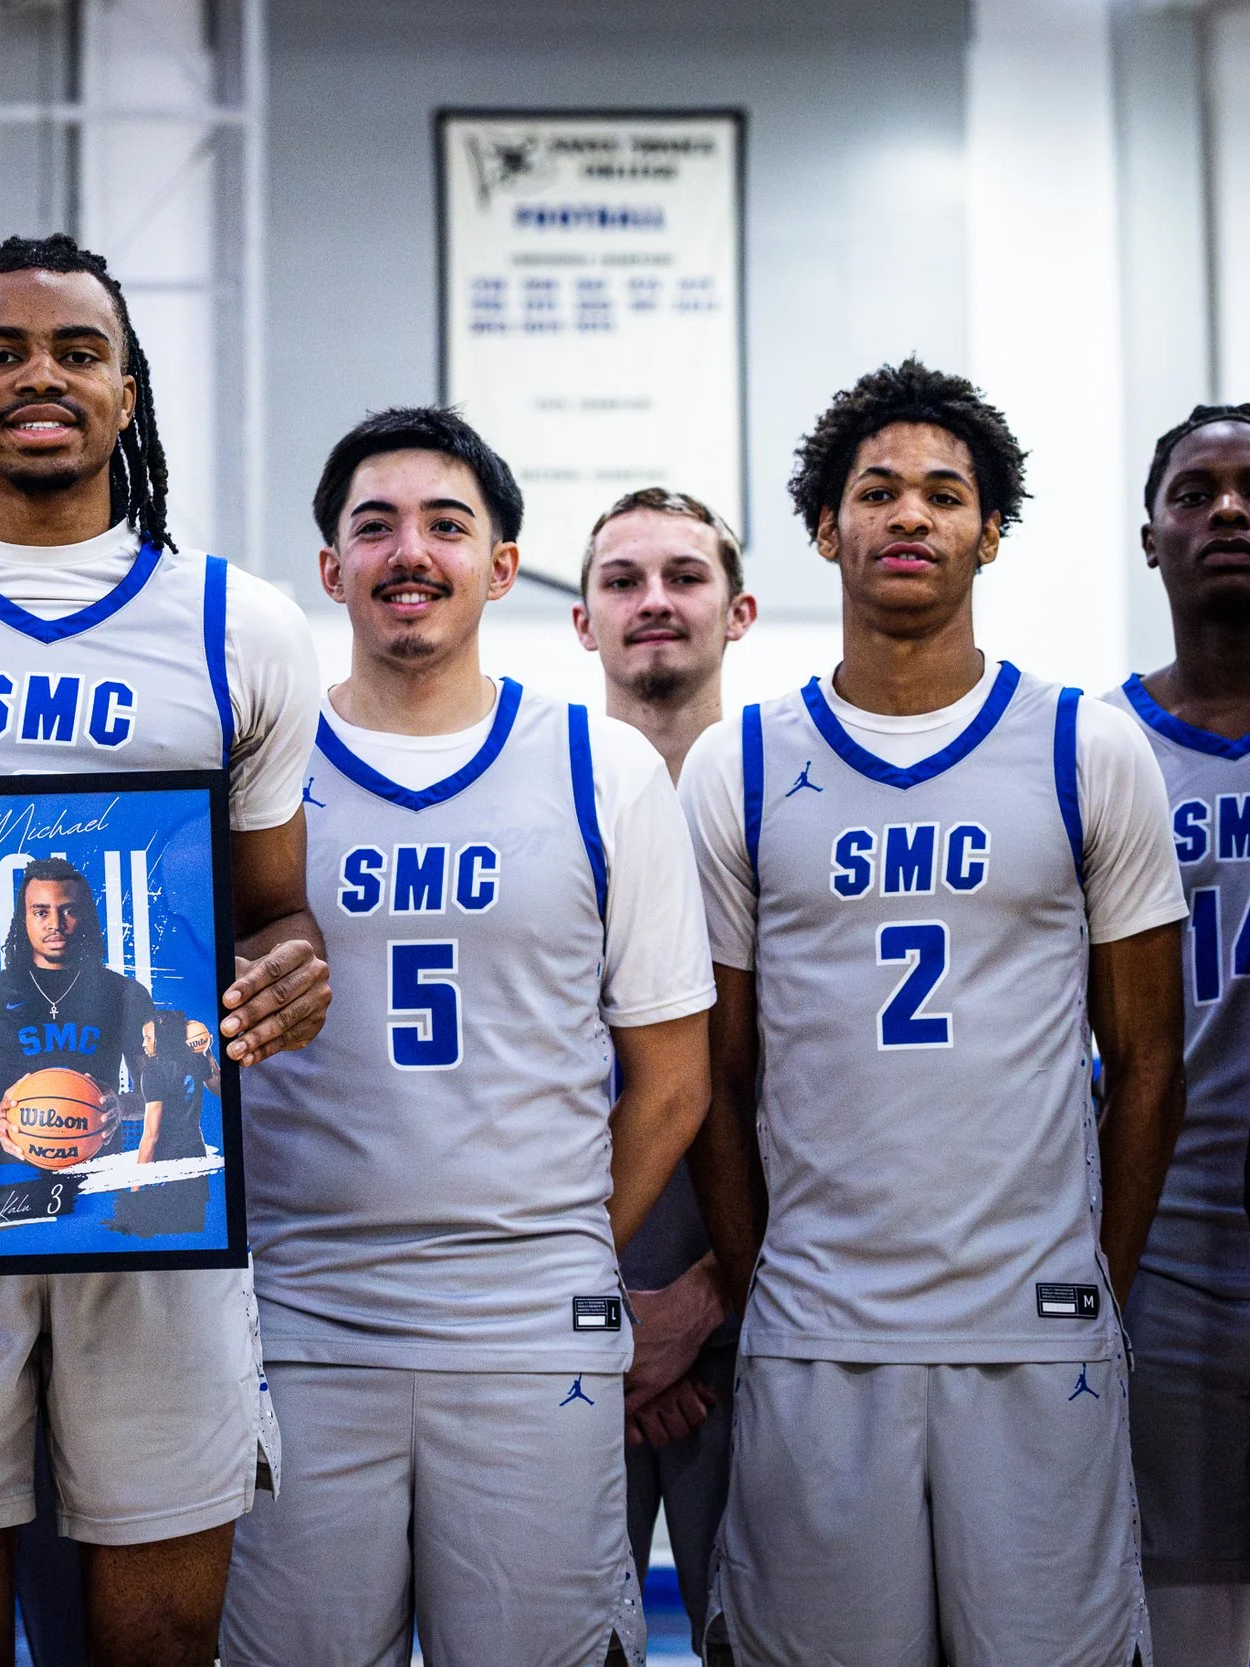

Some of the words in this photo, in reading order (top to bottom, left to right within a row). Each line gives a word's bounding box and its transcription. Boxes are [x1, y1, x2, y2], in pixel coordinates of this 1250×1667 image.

[830, 821, 991, 901] SMC
[337, 842, 501, 917] SMC
[875, 919, 954, 1051] 2
[387, 938, 464, 1071] 5
[18, 1022, 101, 1056] SMC
[20, 1108, 88, 1130] Wilson
[29, 1143, 78, 1159] NCAA
[47, 1183, 63, 1214] 3
[1083, 1295, 1094, 1308] M
